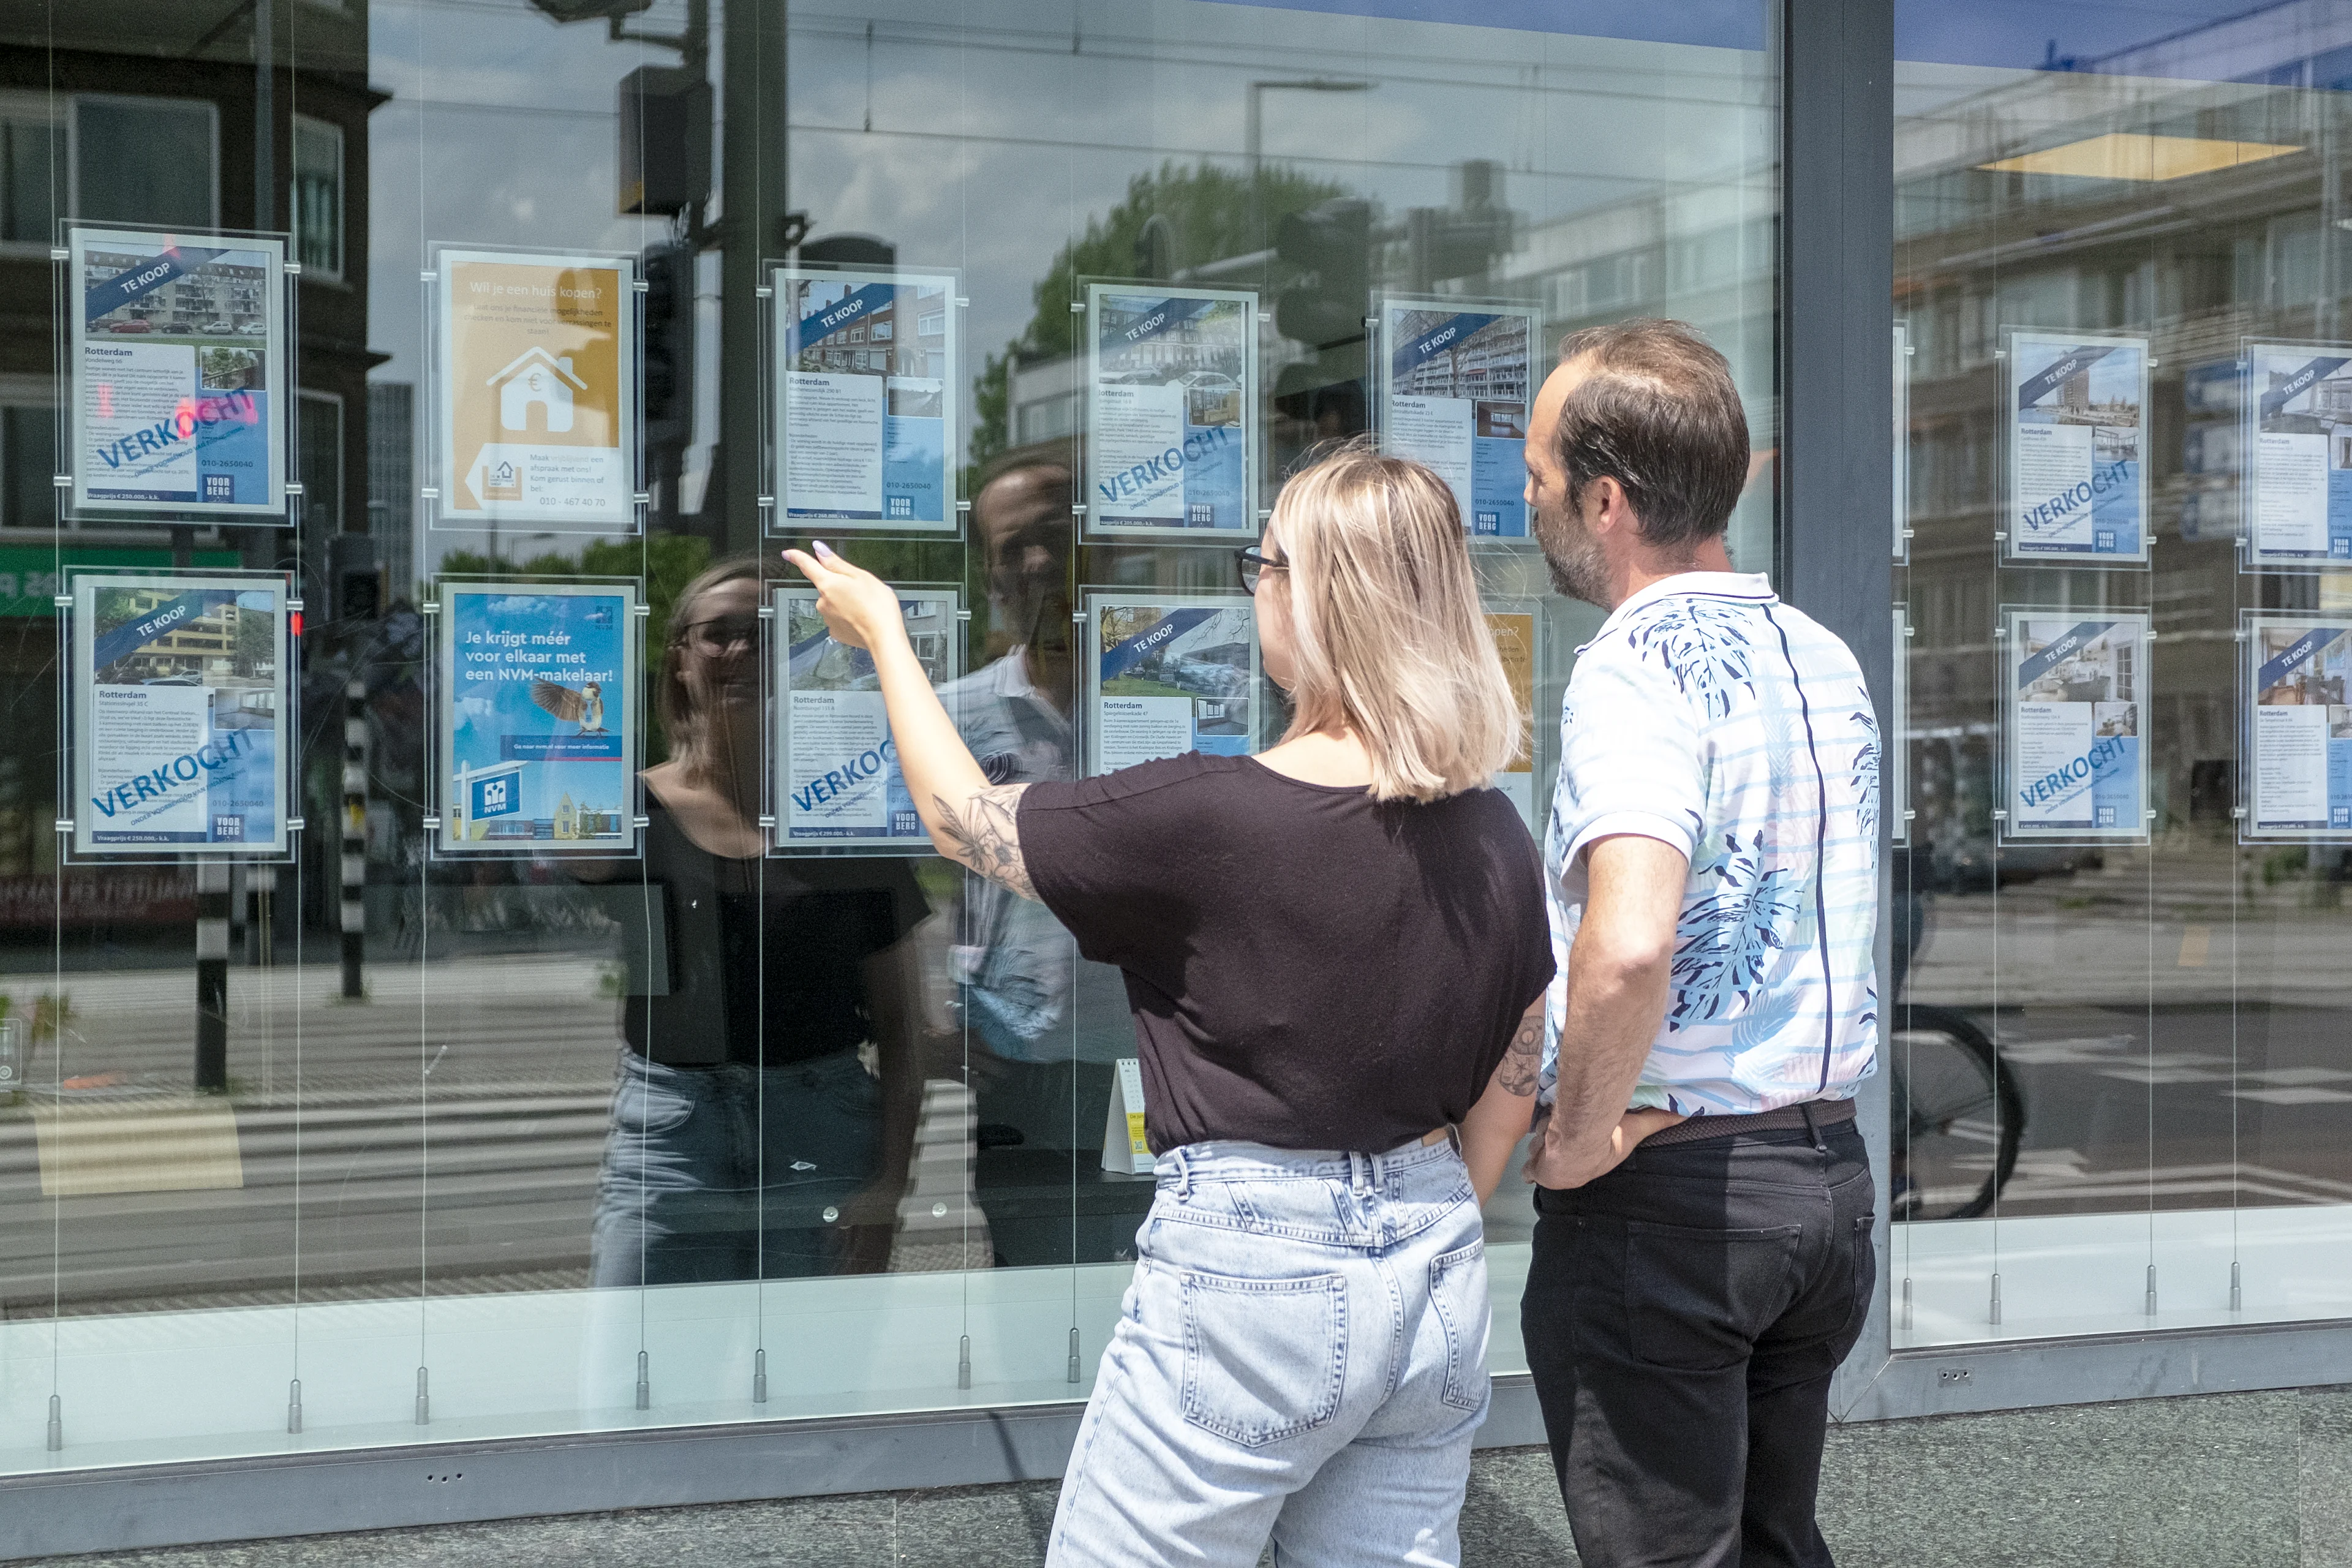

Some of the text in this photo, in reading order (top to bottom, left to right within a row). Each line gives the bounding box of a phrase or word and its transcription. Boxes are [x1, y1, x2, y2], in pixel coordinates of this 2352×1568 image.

[120, 262, 170, 293] TE KOOP
[470, 282, 602, 300] Wil je een huis kopen?
[505, 315, 522, 323] kom
[550, 307, 603, 317] mogelijkheden
[821, 299, 864, 328] TE KOOP
[1125, 312, 1165, 341] TE KOOP
[1419, 327, 1457, 354] TE KOOP
[85, 347, 132, 356] Rotterdam
[2045, 358, 2077, 385] TE KOOP
[789, 377, 830, 386] Rotterdam
[2283, 369, 2315, 394] TE KOOP
[97, 386, 252, 469] VERKOCHT
[202, 459, 254, 468] 010-2650040
[1099, 424, 1229, 502] VERKOCHT
[206, 477, 230, 486] VOOR
[886, 481, 931, 491] 010-2650040
[206, 486, 230, 496] BERG
[2023, 459, 2129, 530] VERKOCHT
[564, 497, 579, 506] 467
[890, 498, 911, 507] VOOR
[1192, 504, 1211, 513] VOOR
[890, 507, 911, 516] BERG
[1192, 513, 1211, 522] BERG
[1479, 513, 1496, 522] VOOR
[136, 605, 186, 636] TE KOOP
[466, 630, 572, 647] Je krijgt méér
[1133, 624, 1174, 653] TE KOOP
[466, 649, 587, 664] voor elkaar met
[2045, 636, 2077, 663] TE KOOP
[2282, 641, 2313, 667] TE KOOP
[466, 668, 613, 682] een NVM-makelaar!
[99, 690, 147, 699] Rotterdam
[91, 726, 254, 818] VERKOCHT
[791, 739, 896, 812] VERKOC
[2019, 733, 2125, 807] VERKOCHT
[484, 803, 507, 813] NVM
[130, 811, 151, 826] ONDER
[217, 817, 240, 826] VOOR
[895, 813, 916, 821] VOOR
[217, 826, 240, 835] BERG
